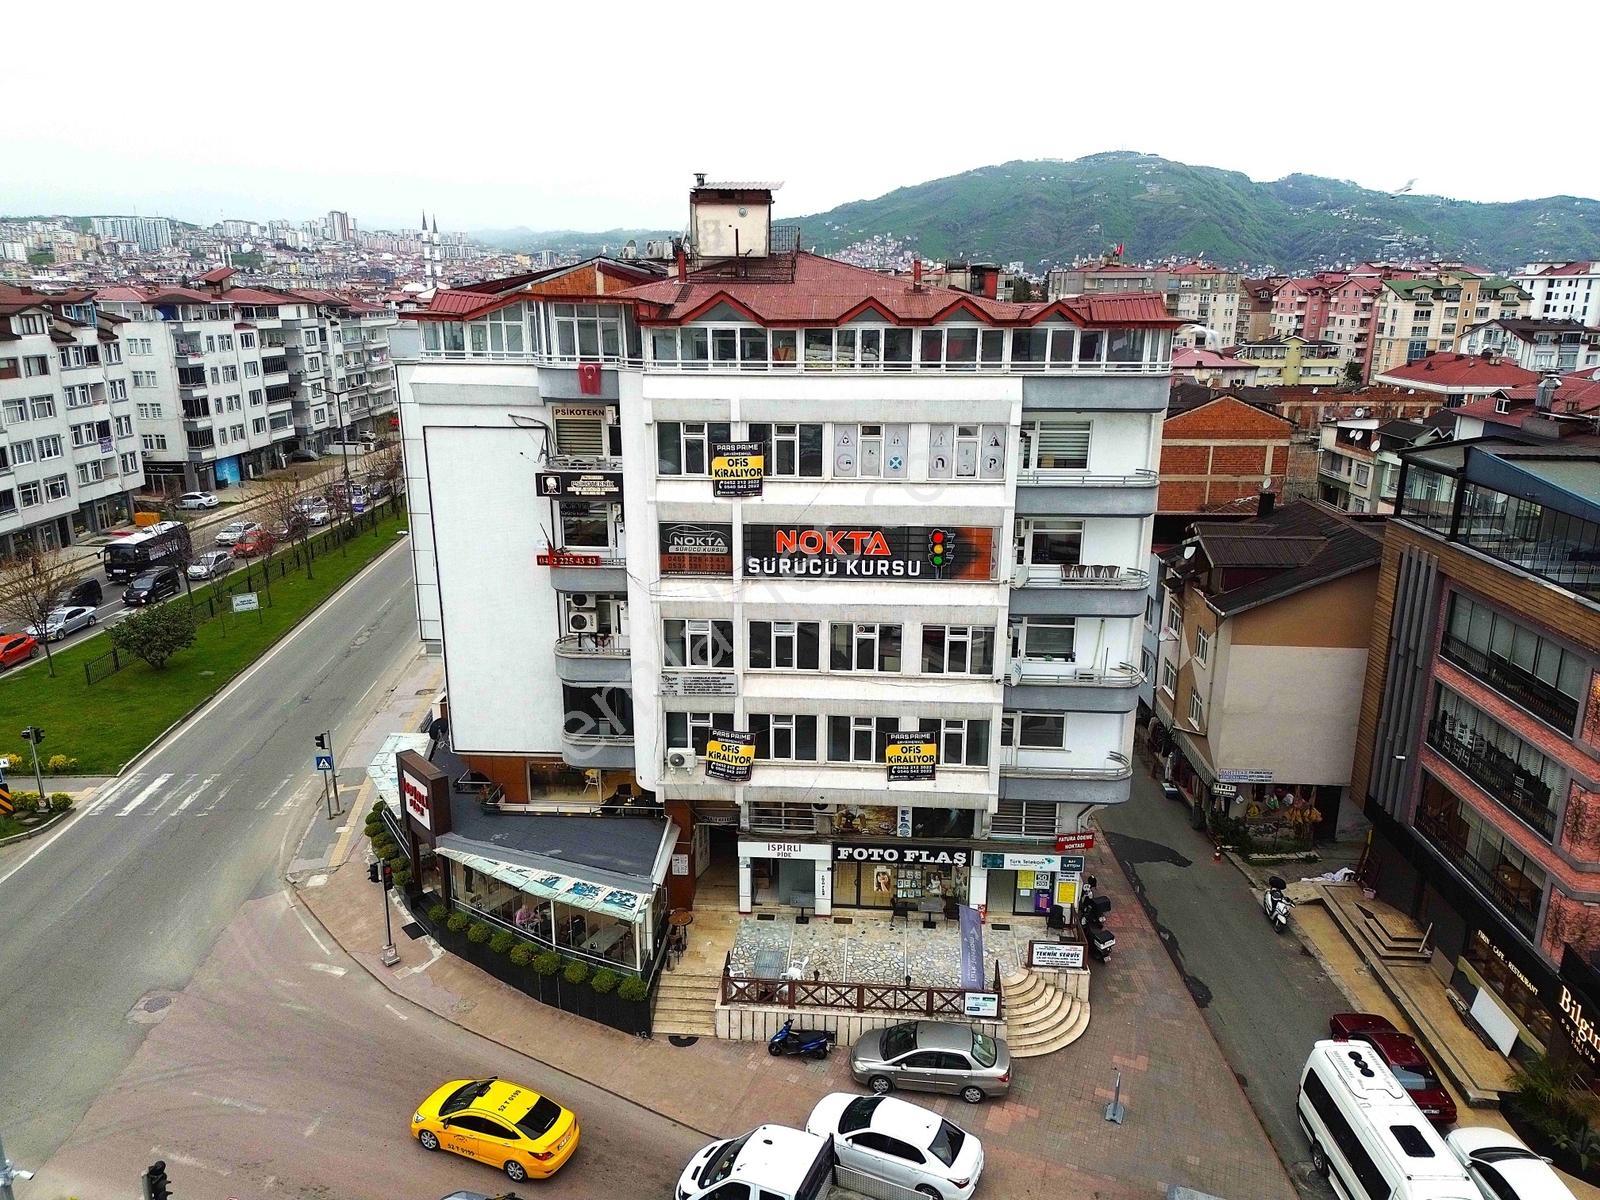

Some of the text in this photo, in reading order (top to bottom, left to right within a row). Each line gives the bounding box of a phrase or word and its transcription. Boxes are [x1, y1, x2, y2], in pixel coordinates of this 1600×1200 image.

[674, 536, 725, 546] NOKTA
[774, 530, 892, 556] NOKTA
[747, 558, 922, 577] SÜRÜCÜ KURSU
[767, 843, 802, 852] İSPİRLİ
[838, 846, 967, 868] FOTO FLAŞ
[1492, 945, 1505, 961] CAFE
[1508, 961, 1539, 996] RESTAURANT
[498, 1104, 508, 1112] 52
